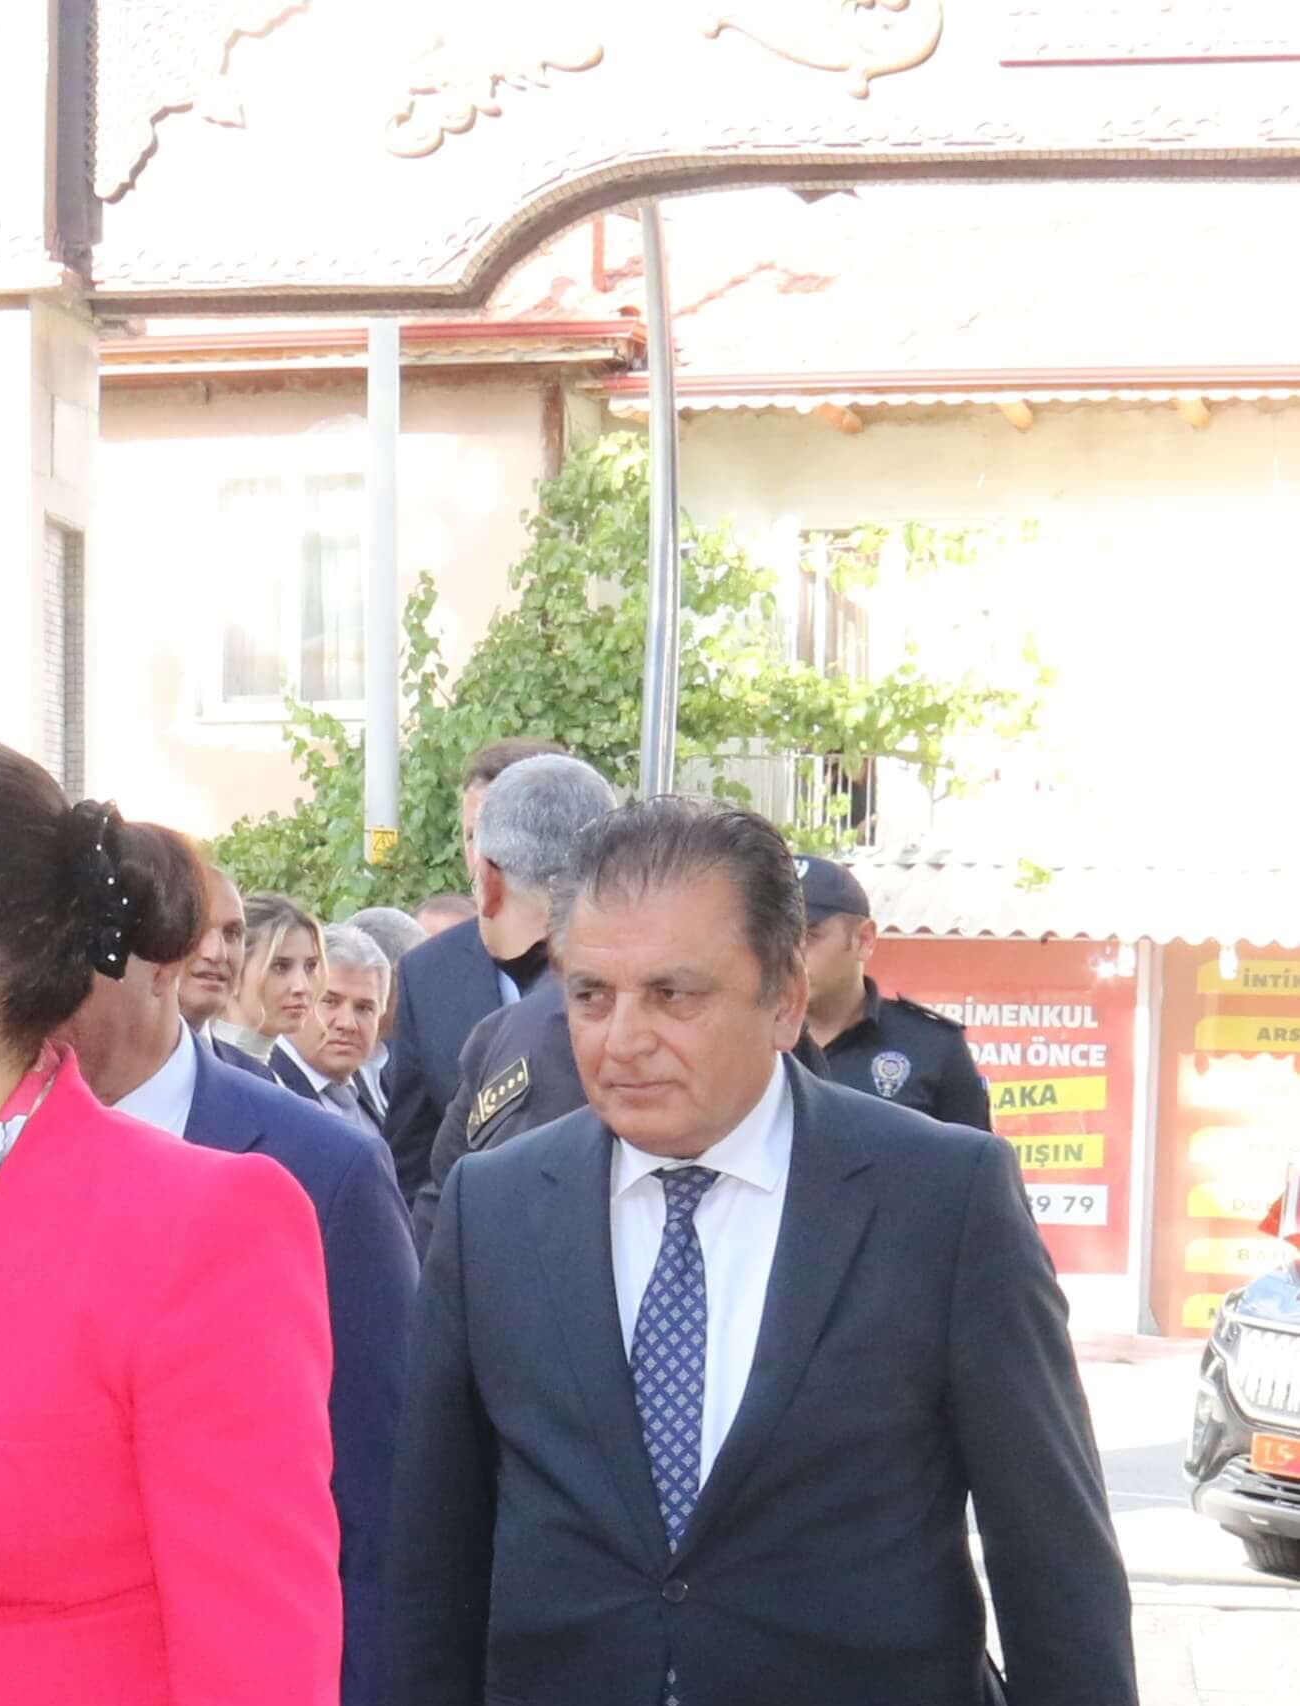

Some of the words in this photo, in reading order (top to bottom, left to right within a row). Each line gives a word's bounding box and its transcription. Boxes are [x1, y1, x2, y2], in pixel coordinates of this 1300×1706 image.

[1026, 1035, 1107, 1068] ÖNCE
[993, 1083, 1058, 1110] AKA
[1062, 1195, 1095, 1213] 79
